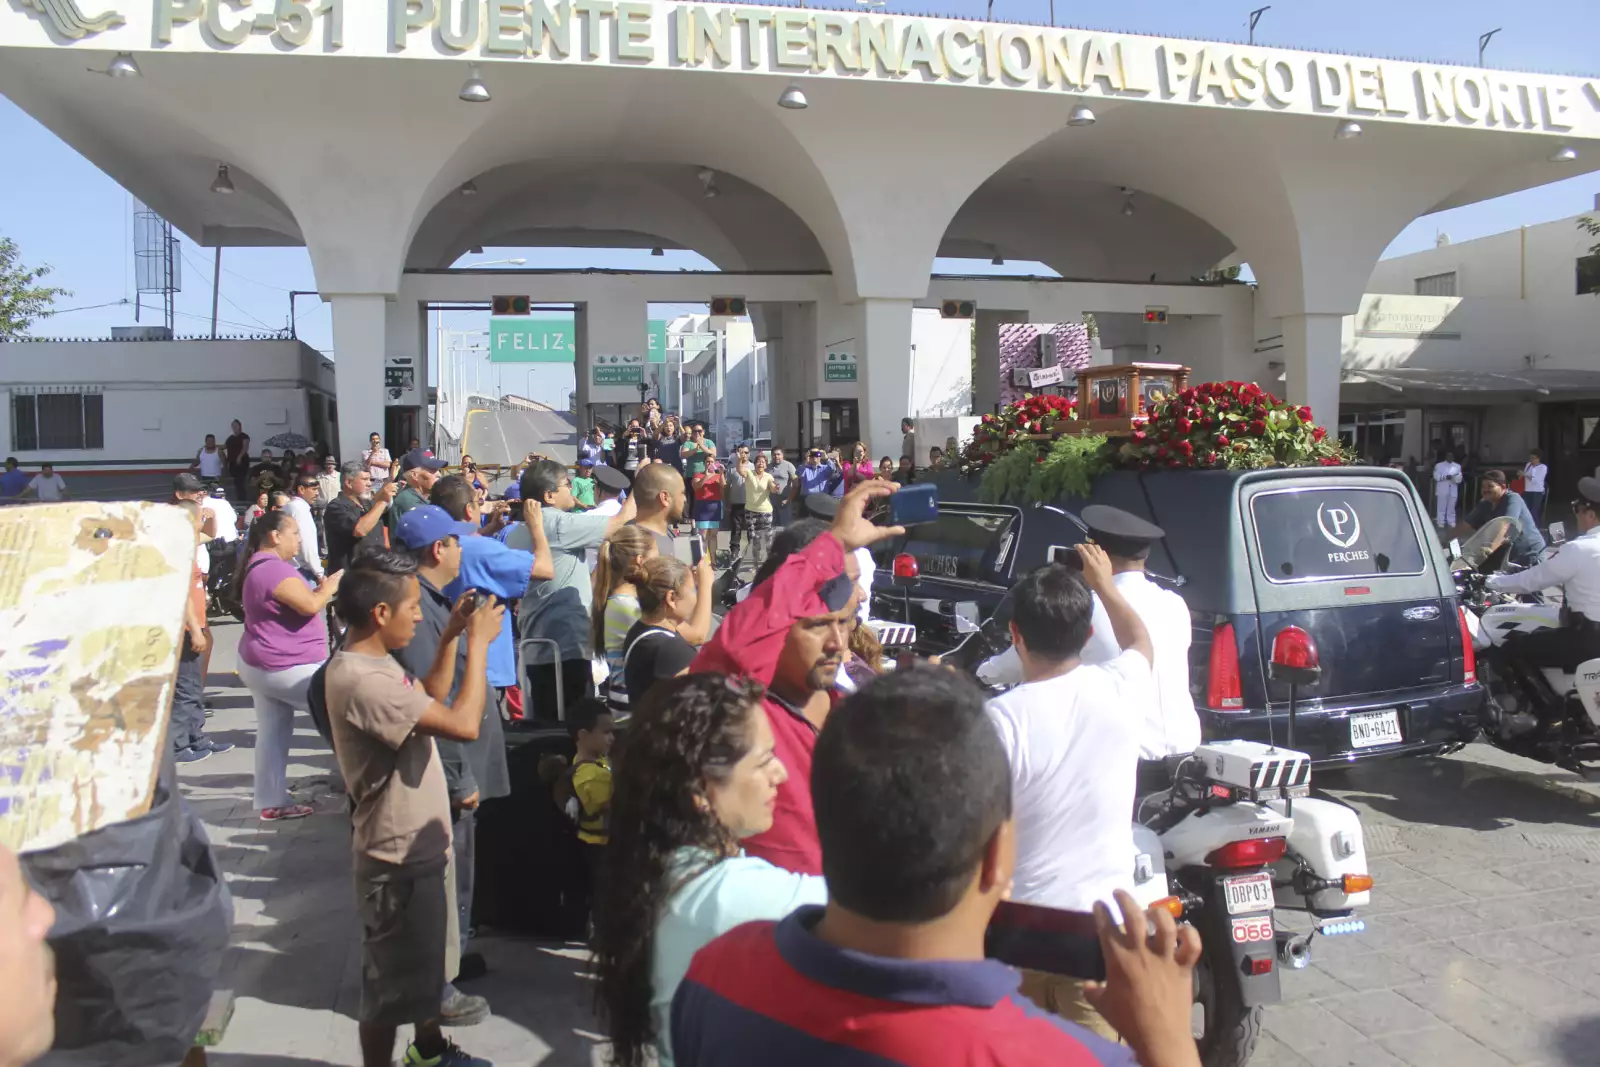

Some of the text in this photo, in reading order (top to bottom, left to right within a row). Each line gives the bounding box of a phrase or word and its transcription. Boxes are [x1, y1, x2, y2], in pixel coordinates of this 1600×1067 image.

[152, 0, 344, 50] PC-51
[388, 0, 655, 63] PUENTE
[668, 4, 1152, 97] INTERNACIONAL
[1156, 43, 1297, 109] PASO
[1308, 58, 1409, 118] DEL
[1413, 67, 1576, 132] NORTE
[497, 332, 564, 350] FELIZ
[1327, 508, 1348, 535] P
[1328, 550, 1369, 563] PERCHES
[1364, 711, 1383, 720] TEXAS
[1249, 824, 1280, 835] YAMAHA
[1232, 883, 1268, 904] DBP03
[1233, 925, 1273, 941] 066
